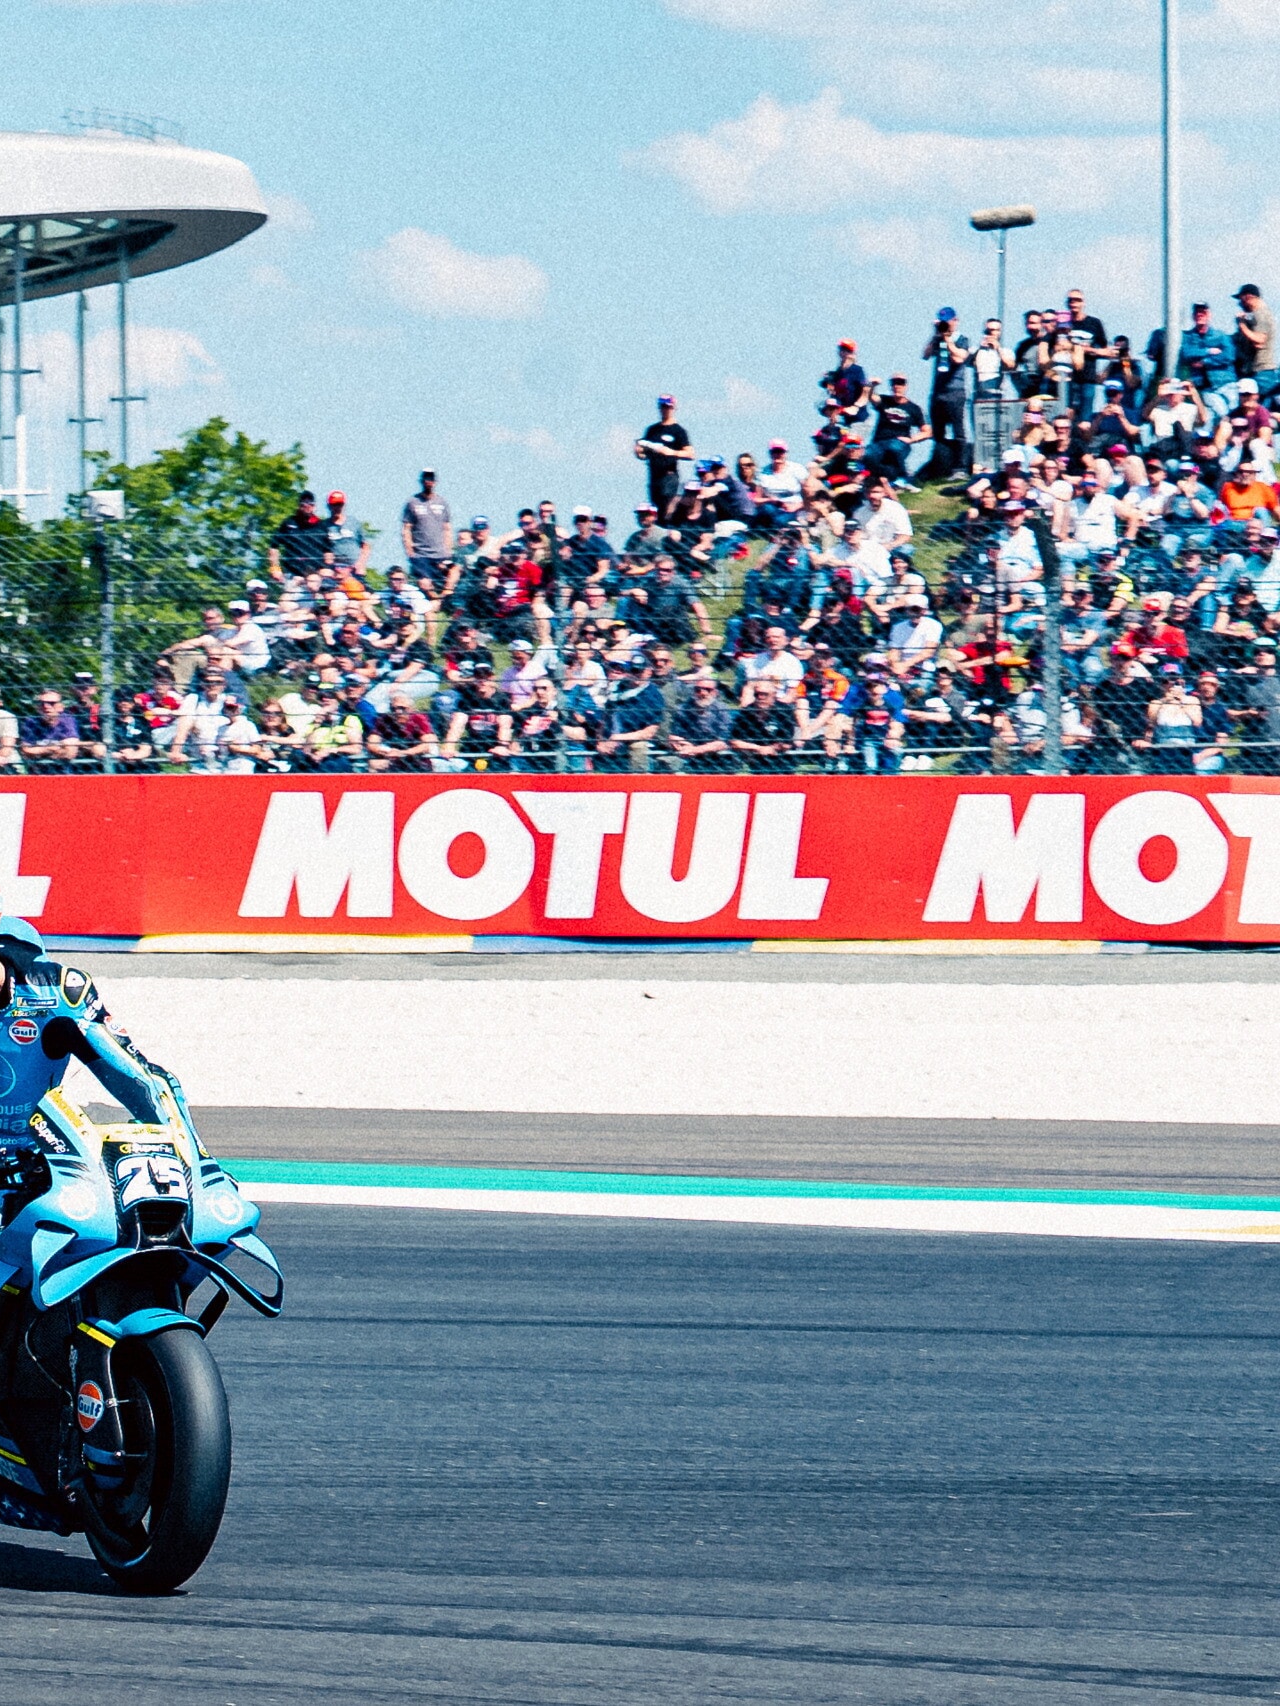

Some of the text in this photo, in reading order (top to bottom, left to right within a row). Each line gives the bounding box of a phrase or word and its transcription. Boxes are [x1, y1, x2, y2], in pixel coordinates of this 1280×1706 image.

[237, 788, 830, 923] MOTUL
[11, 1026, 38, 1037] Gulf
[114, 1154, 190, 1212] 25
[77, 1399, 102, 1418] Gulf
